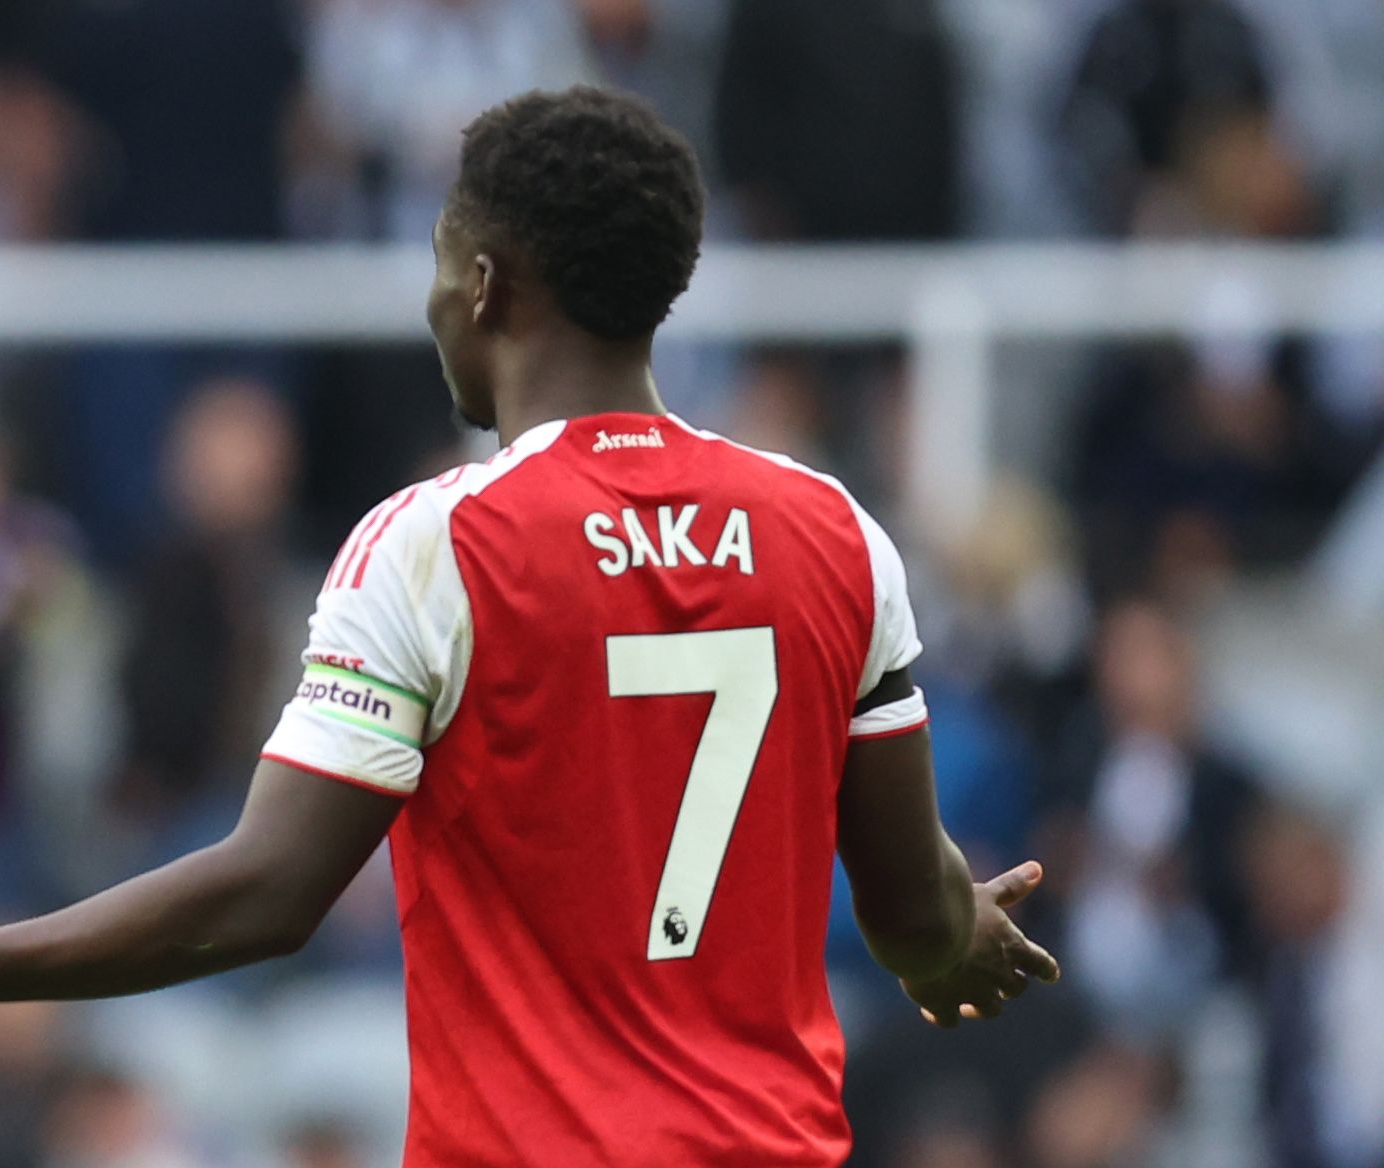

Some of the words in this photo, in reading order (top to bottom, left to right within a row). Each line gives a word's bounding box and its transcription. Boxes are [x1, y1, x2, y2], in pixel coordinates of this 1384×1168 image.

[591, 427, 666, 453] Arsenal
[582, 503, 755, 577] SAKA
[299, 680, 393, 720] aptain
[604, 624, 779, 961] 7
